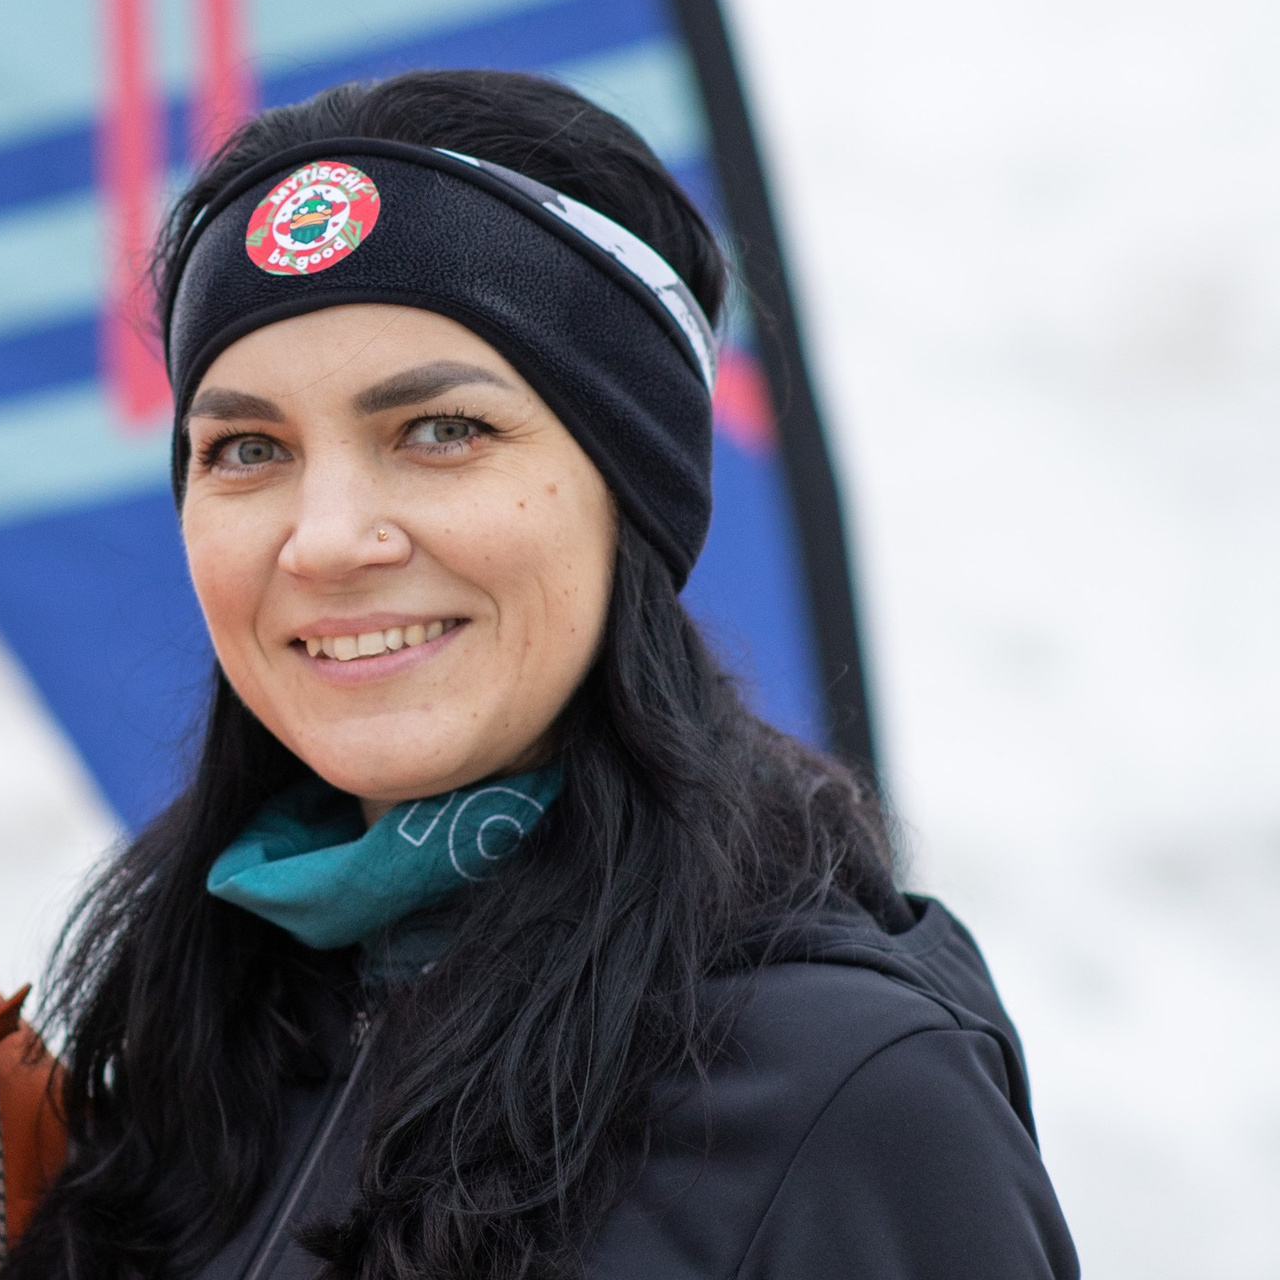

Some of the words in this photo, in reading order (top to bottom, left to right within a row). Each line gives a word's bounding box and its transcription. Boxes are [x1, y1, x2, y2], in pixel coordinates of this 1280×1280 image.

[269, 166, 367, 205] MYTISCHI
[267, 248, 289, 266] be
[295, 236, 347, 270] good
